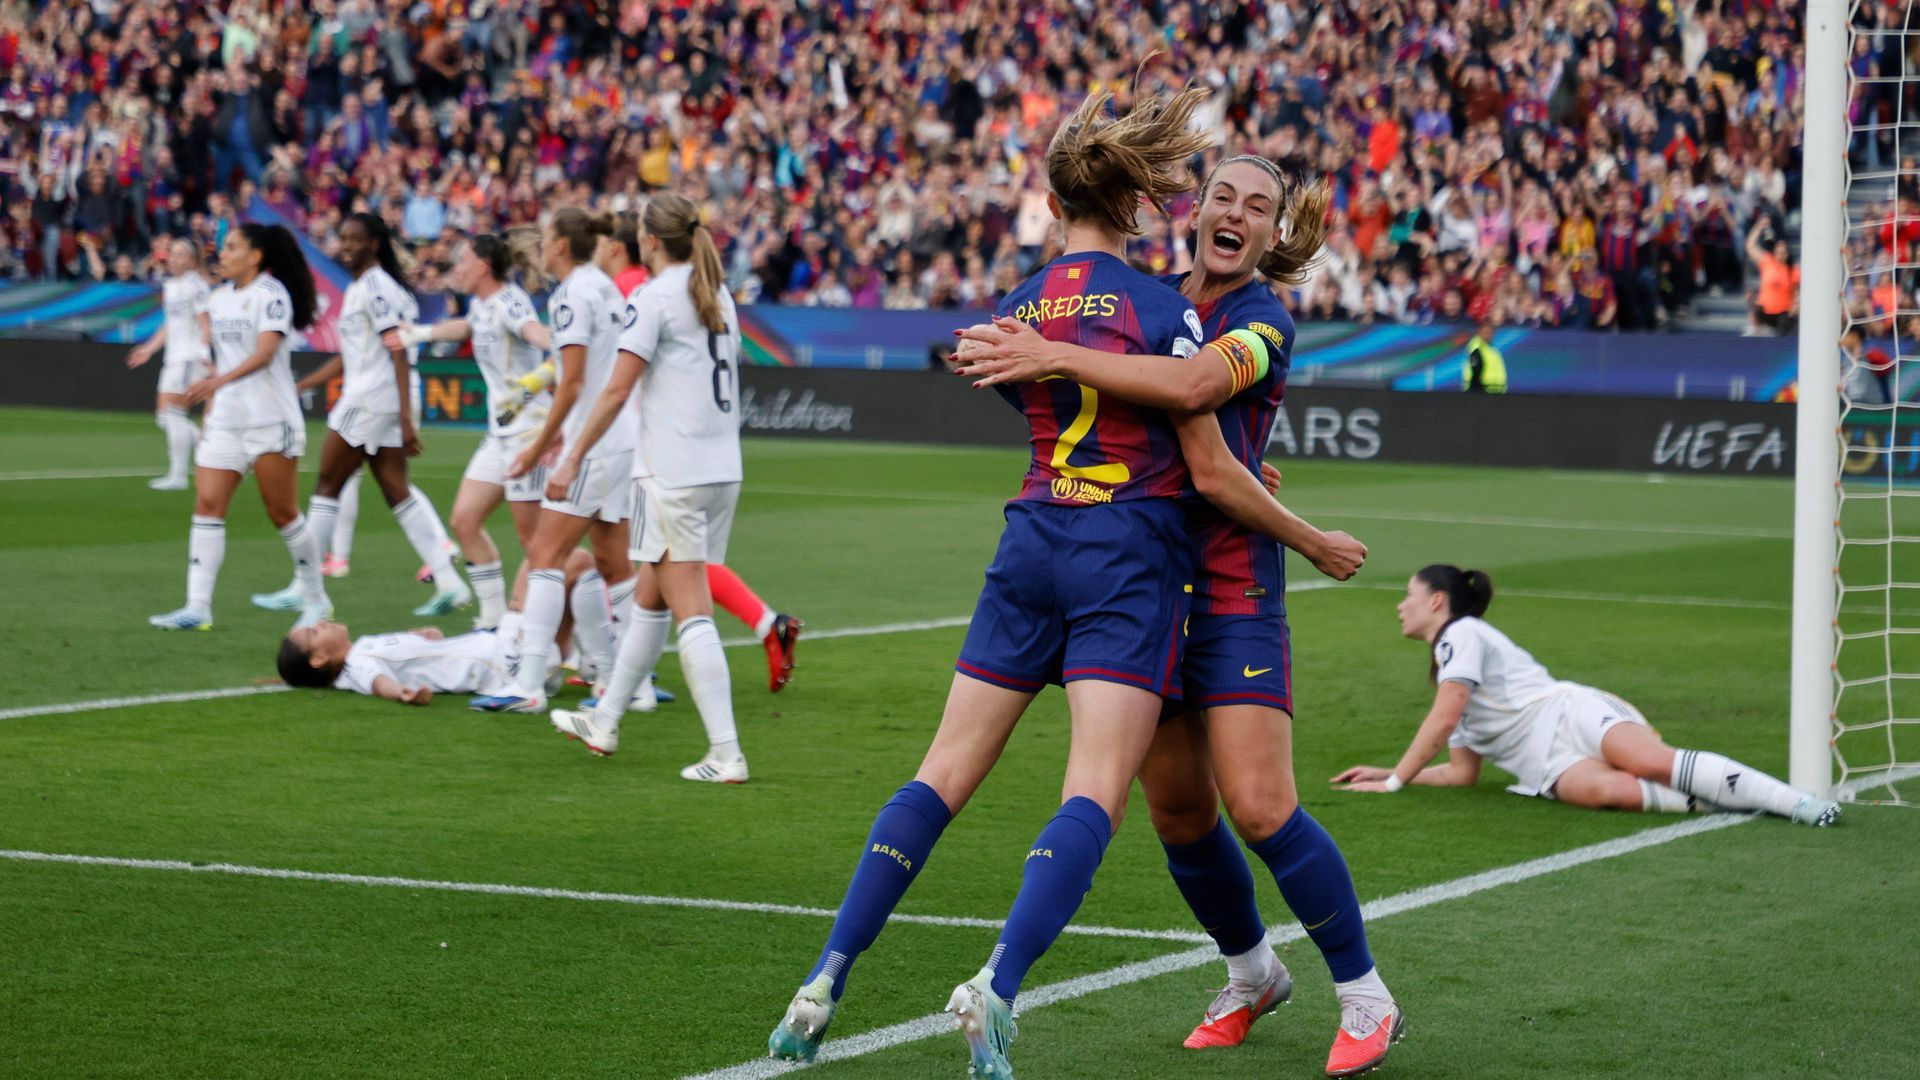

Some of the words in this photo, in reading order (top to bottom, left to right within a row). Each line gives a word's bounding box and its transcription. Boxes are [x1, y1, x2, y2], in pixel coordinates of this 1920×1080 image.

[1015, 294, 1119, 325] PAREDES
[739, 387, 853, 431] hildren
[1036, 374, 1130, 484] 2
[1264, 406, 1381, 459] ARS
[1652, 420, 1786, 471] UEFA
